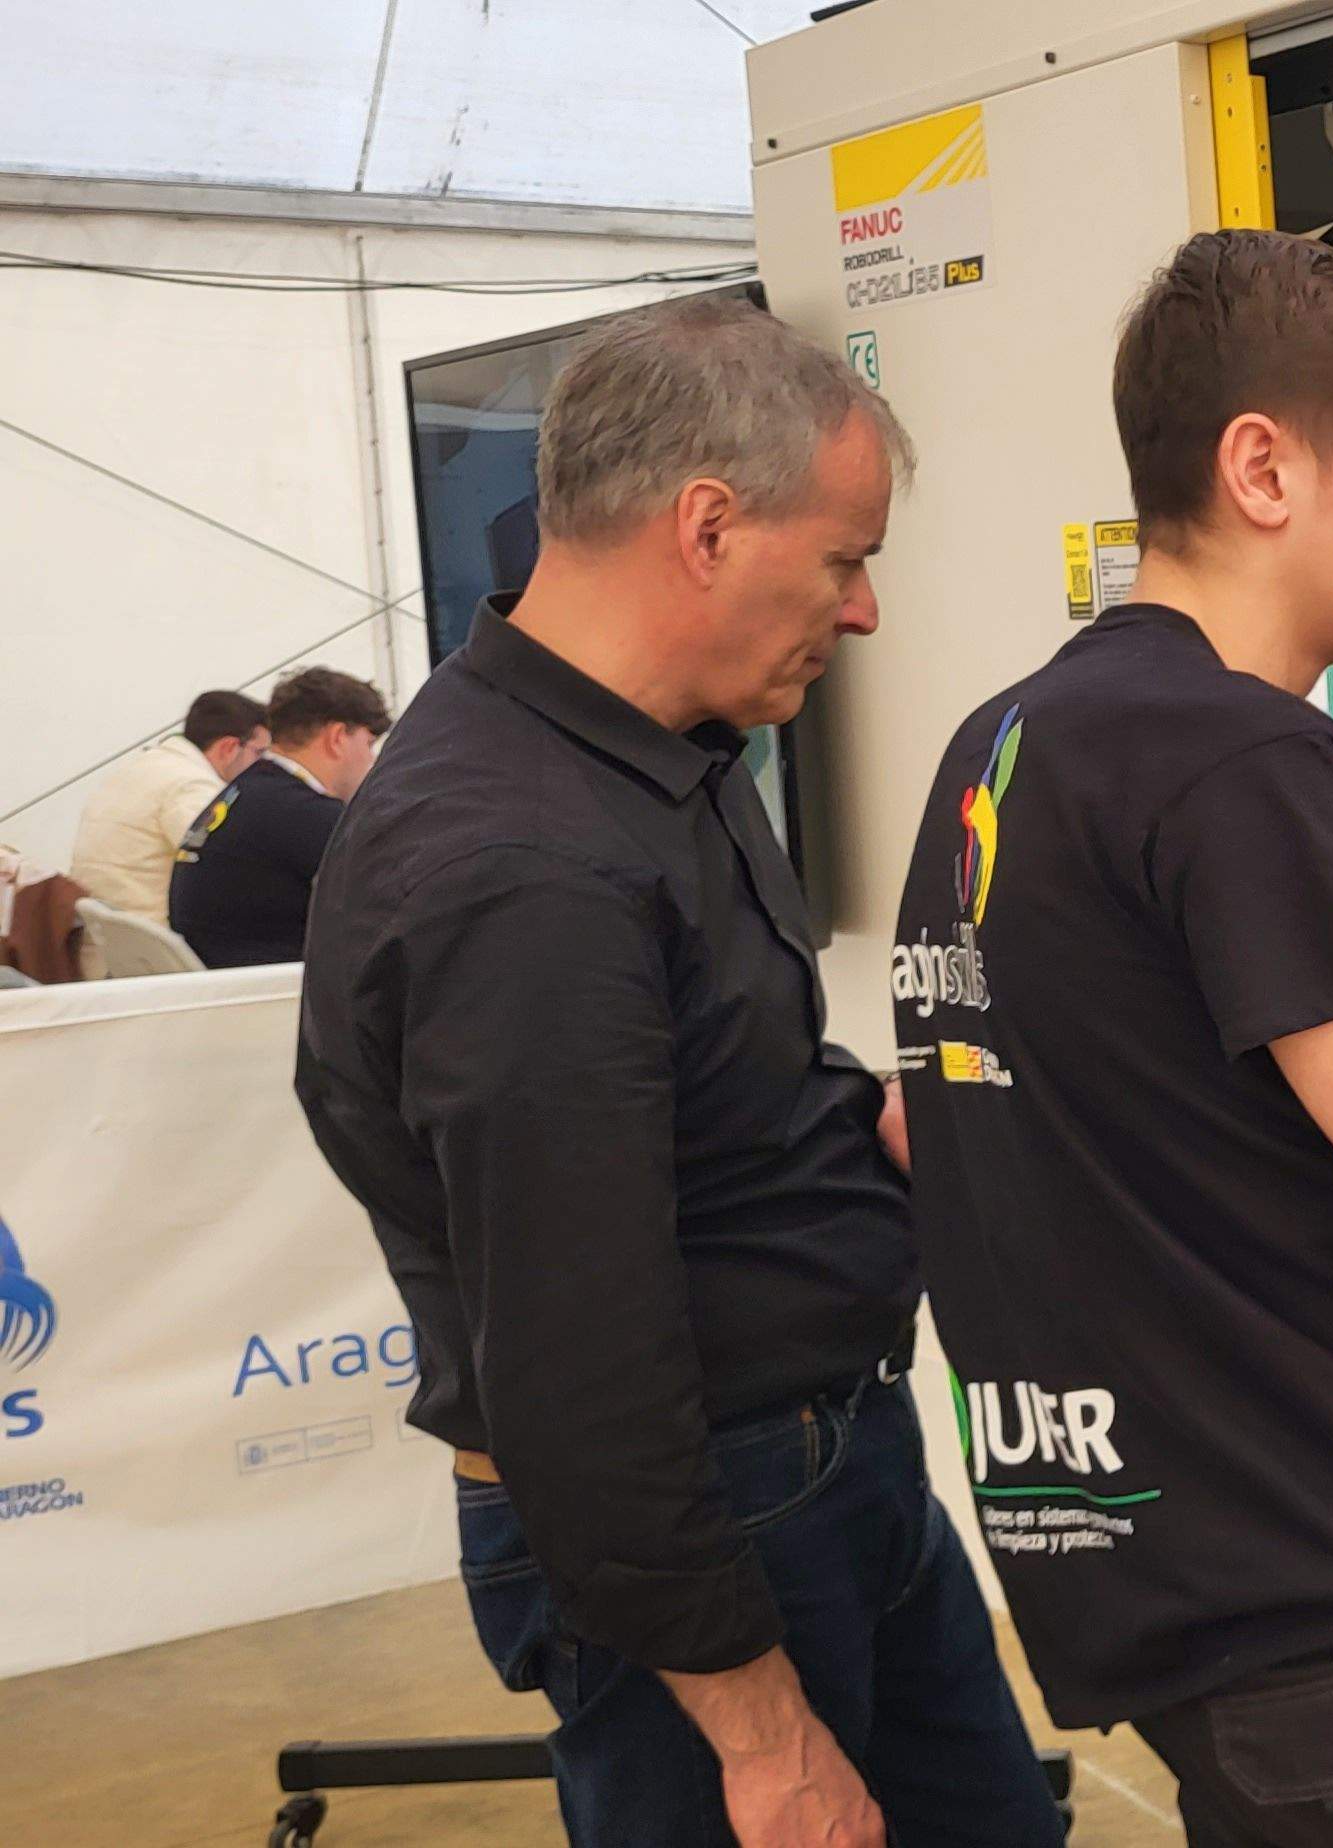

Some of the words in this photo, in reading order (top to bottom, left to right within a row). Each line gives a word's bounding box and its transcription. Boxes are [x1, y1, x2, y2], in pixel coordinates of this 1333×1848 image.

[840, 207, 903, 245] FANUC
[843, 245, 904, 272] ROBODRILL
[947, 262, 980, 285] Plus
